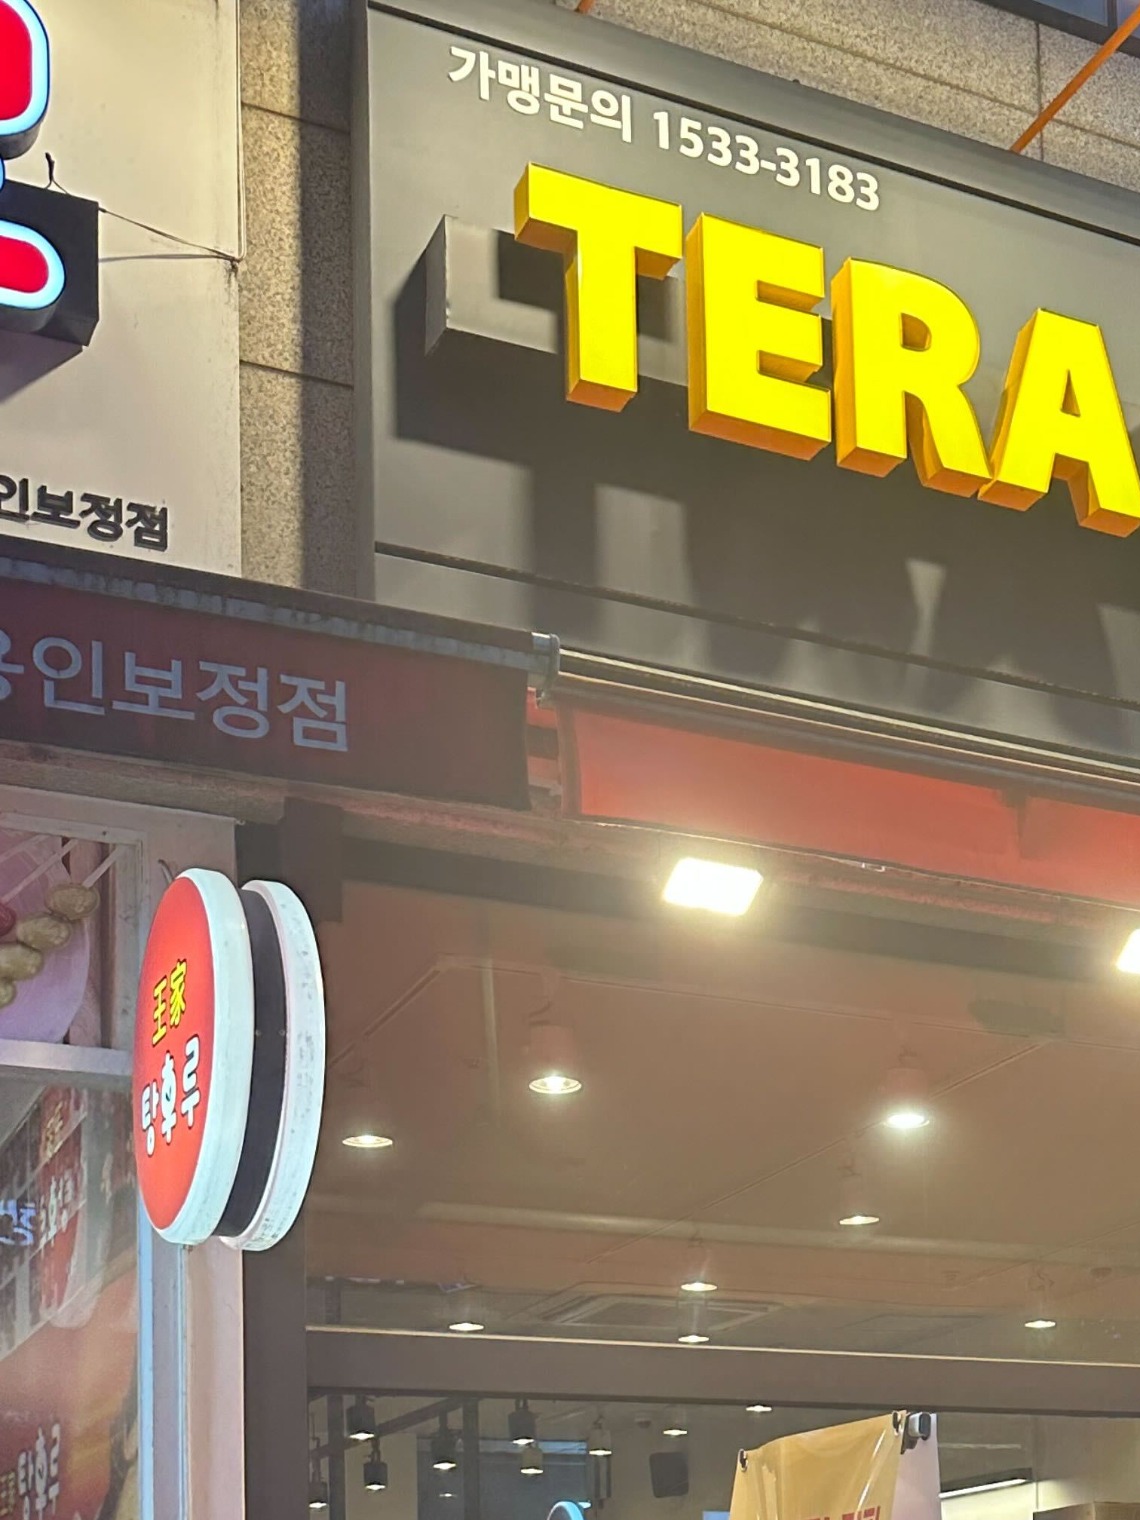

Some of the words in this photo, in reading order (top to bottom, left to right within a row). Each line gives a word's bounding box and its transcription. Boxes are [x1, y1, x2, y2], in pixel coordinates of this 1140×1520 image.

[448, 45, 635, 143] 가맹문의
[652, 110, 881, 211] 1533-3183
[152, 958, 188, 1046] 王家
[141, 1035, 200, 1157] 탕후루
